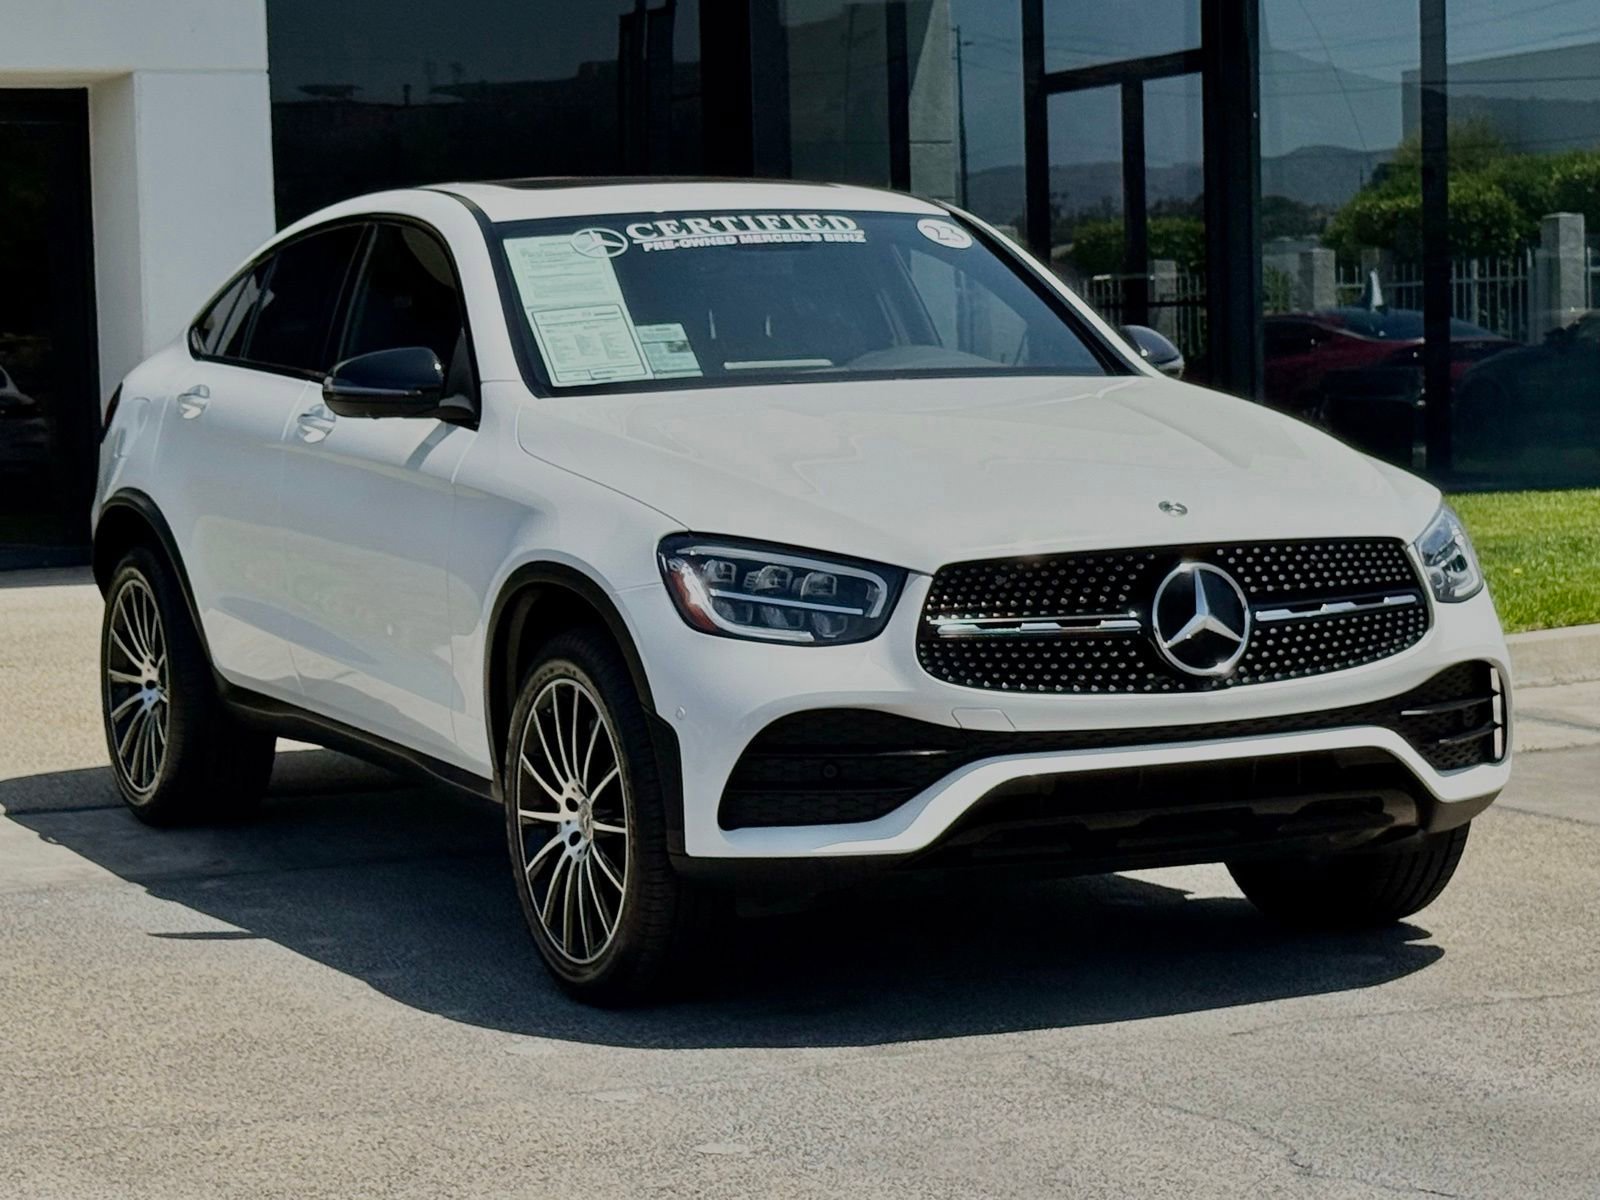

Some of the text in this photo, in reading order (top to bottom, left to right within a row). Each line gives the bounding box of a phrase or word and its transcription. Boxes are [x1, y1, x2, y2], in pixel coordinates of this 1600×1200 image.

[626, 215, 857, 239] CERTIFIED
[642, 233, 867, 251] PRE-OWNED MERCEDES BENZ
